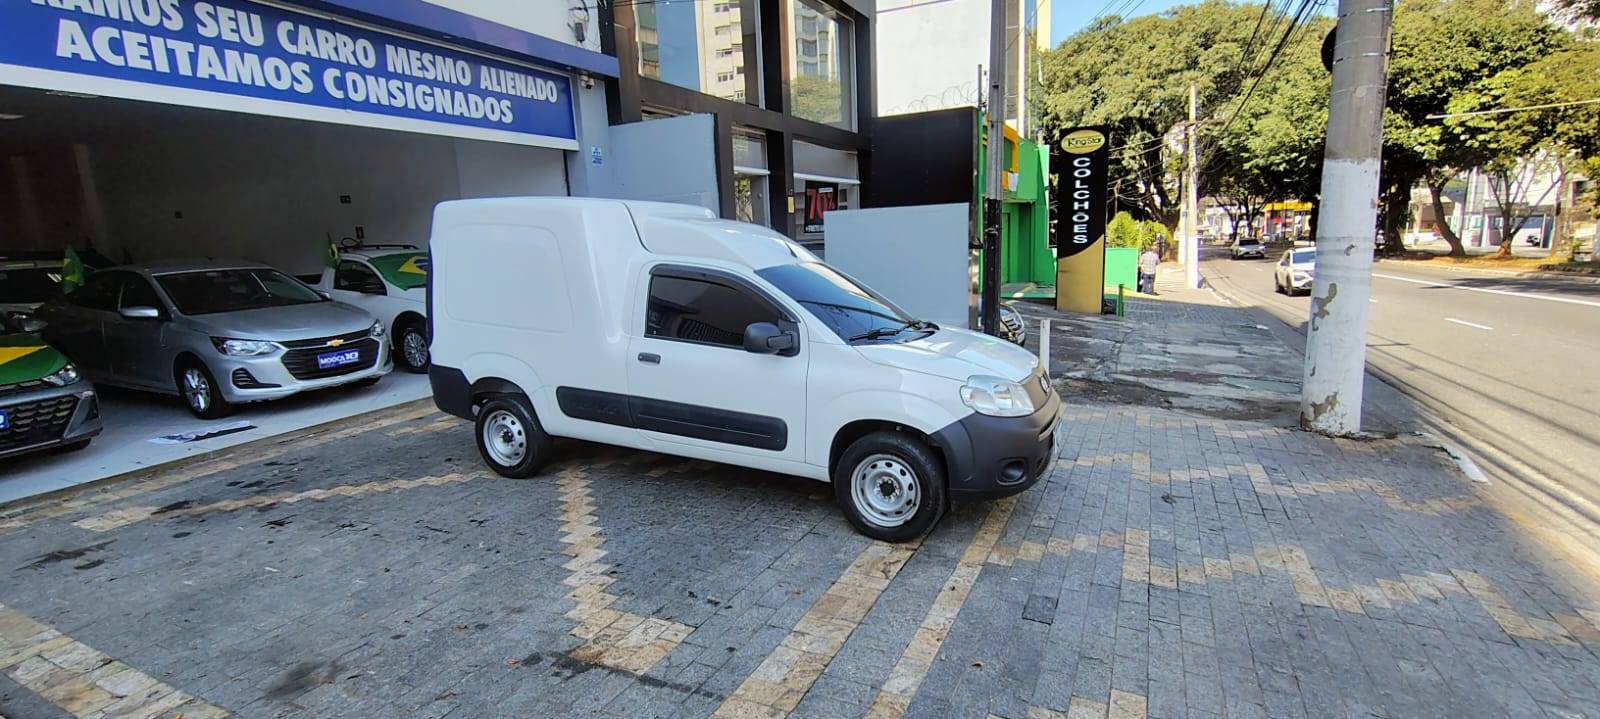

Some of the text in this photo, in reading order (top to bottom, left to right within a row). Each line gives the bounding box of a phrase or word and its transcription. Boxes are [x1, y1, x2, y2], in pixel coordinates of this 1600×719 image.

[56, 18, 514, 124] ACEITAMOS CONSIGNADOS
[194, 3, 265, 47] SEU
[277, 20, 376, 69] CARRO
[386, 44, 472, 87] MESMO
[480, 65, 558, 103] ALIENADO
[1073, 157, 1091, 243] COLCHÕES
